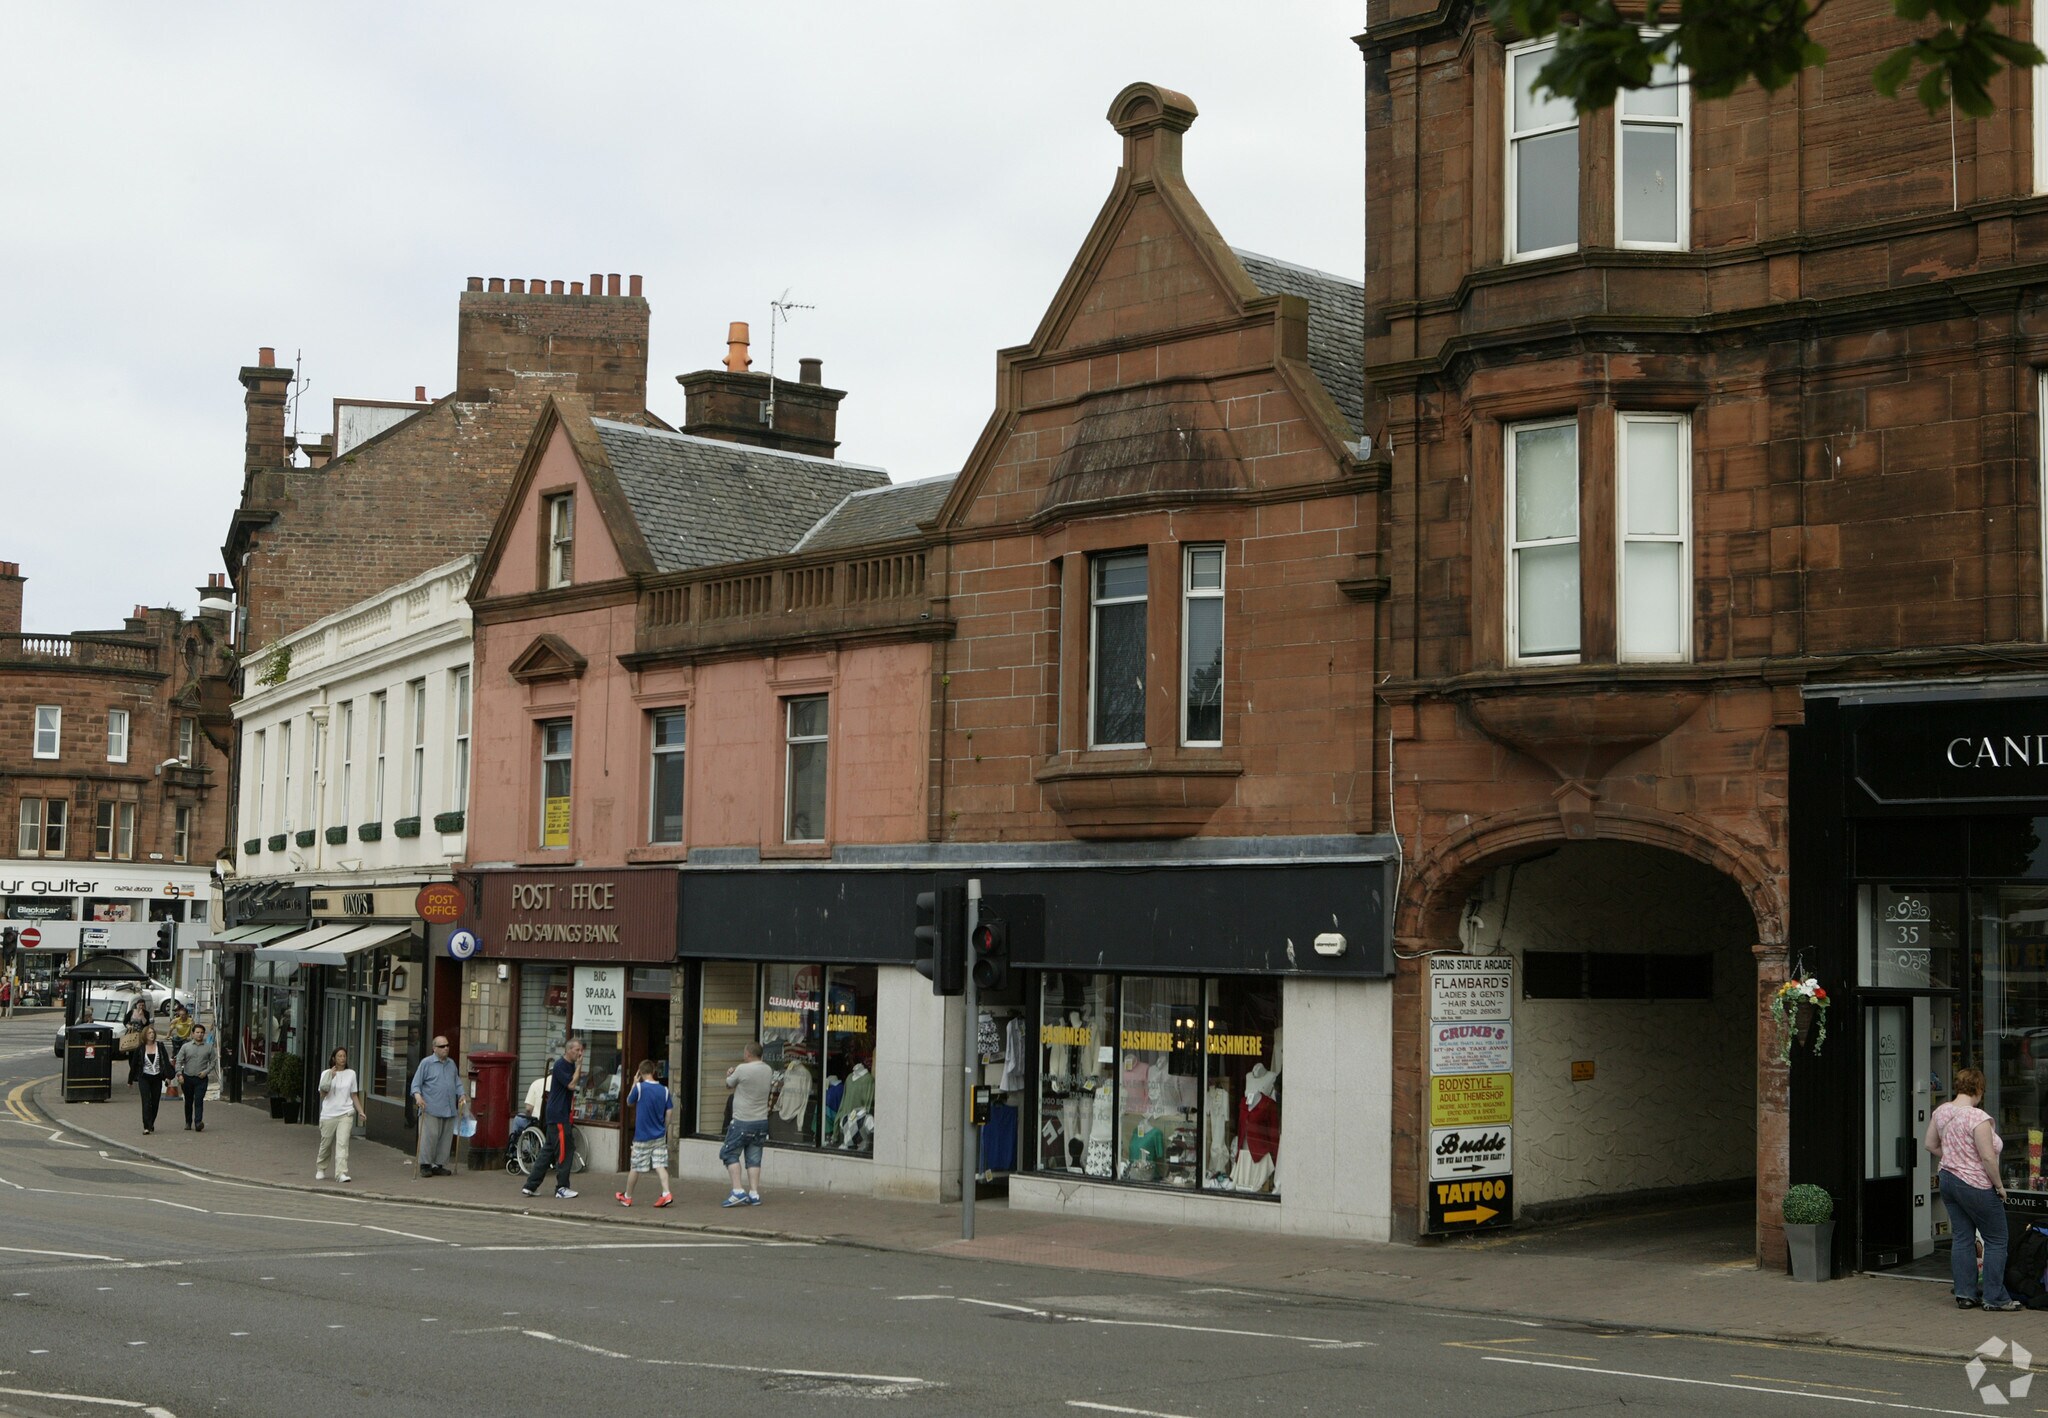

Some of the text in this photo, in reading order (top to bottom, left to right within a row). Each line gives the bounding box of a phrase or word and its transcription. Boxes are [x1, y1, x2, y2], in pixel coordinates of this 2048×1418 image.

[31, 879, 99, 895] guitar
[429, 895, 454, 905] POST
[512, 884, 555, 910] POST
[17, 906, 58, 914] Blackstar
[424, 905, 457, 915] OFFICE
[505, 923, 619, 943] AND SAVINGS BANK
[1897, 926, 1919, 943] 35
[1430, 959, 1512, 970] BURNS STATUE ARCADE
[593, 971, 607, 981] BIG
[1434, 977, 1509, 989] FLAMBARD'S
[585, 987, 616, 999] SPARRA
[588, 1004, 613, 1016] VINYL
[769, 996, 819, 1011] CLEARANCE SALE
[702, 1008, 738, 1025] CASHMERE
[763, 1011, 801, 1028] CASHMERE
[827, 1014, 868, 1033] CASHMERE
[1040, 1025, 1092, 1047] CASHMERE
[1120, 1030, 1174, 1052] CASHMERE
[1439, 1026, 1505, 1041] CRUMB'S
[1206, 1034, 1262, 1056] CASHMERE
[1439, 1077, 1492, 1091] BODYSTYLE
[1440, 1091, 1504, 1102] ADULT THEMESHOP
[1436, 1132, 1506, 1155] Budds
[1437, 1179, 1506, 1205] TATTOO
